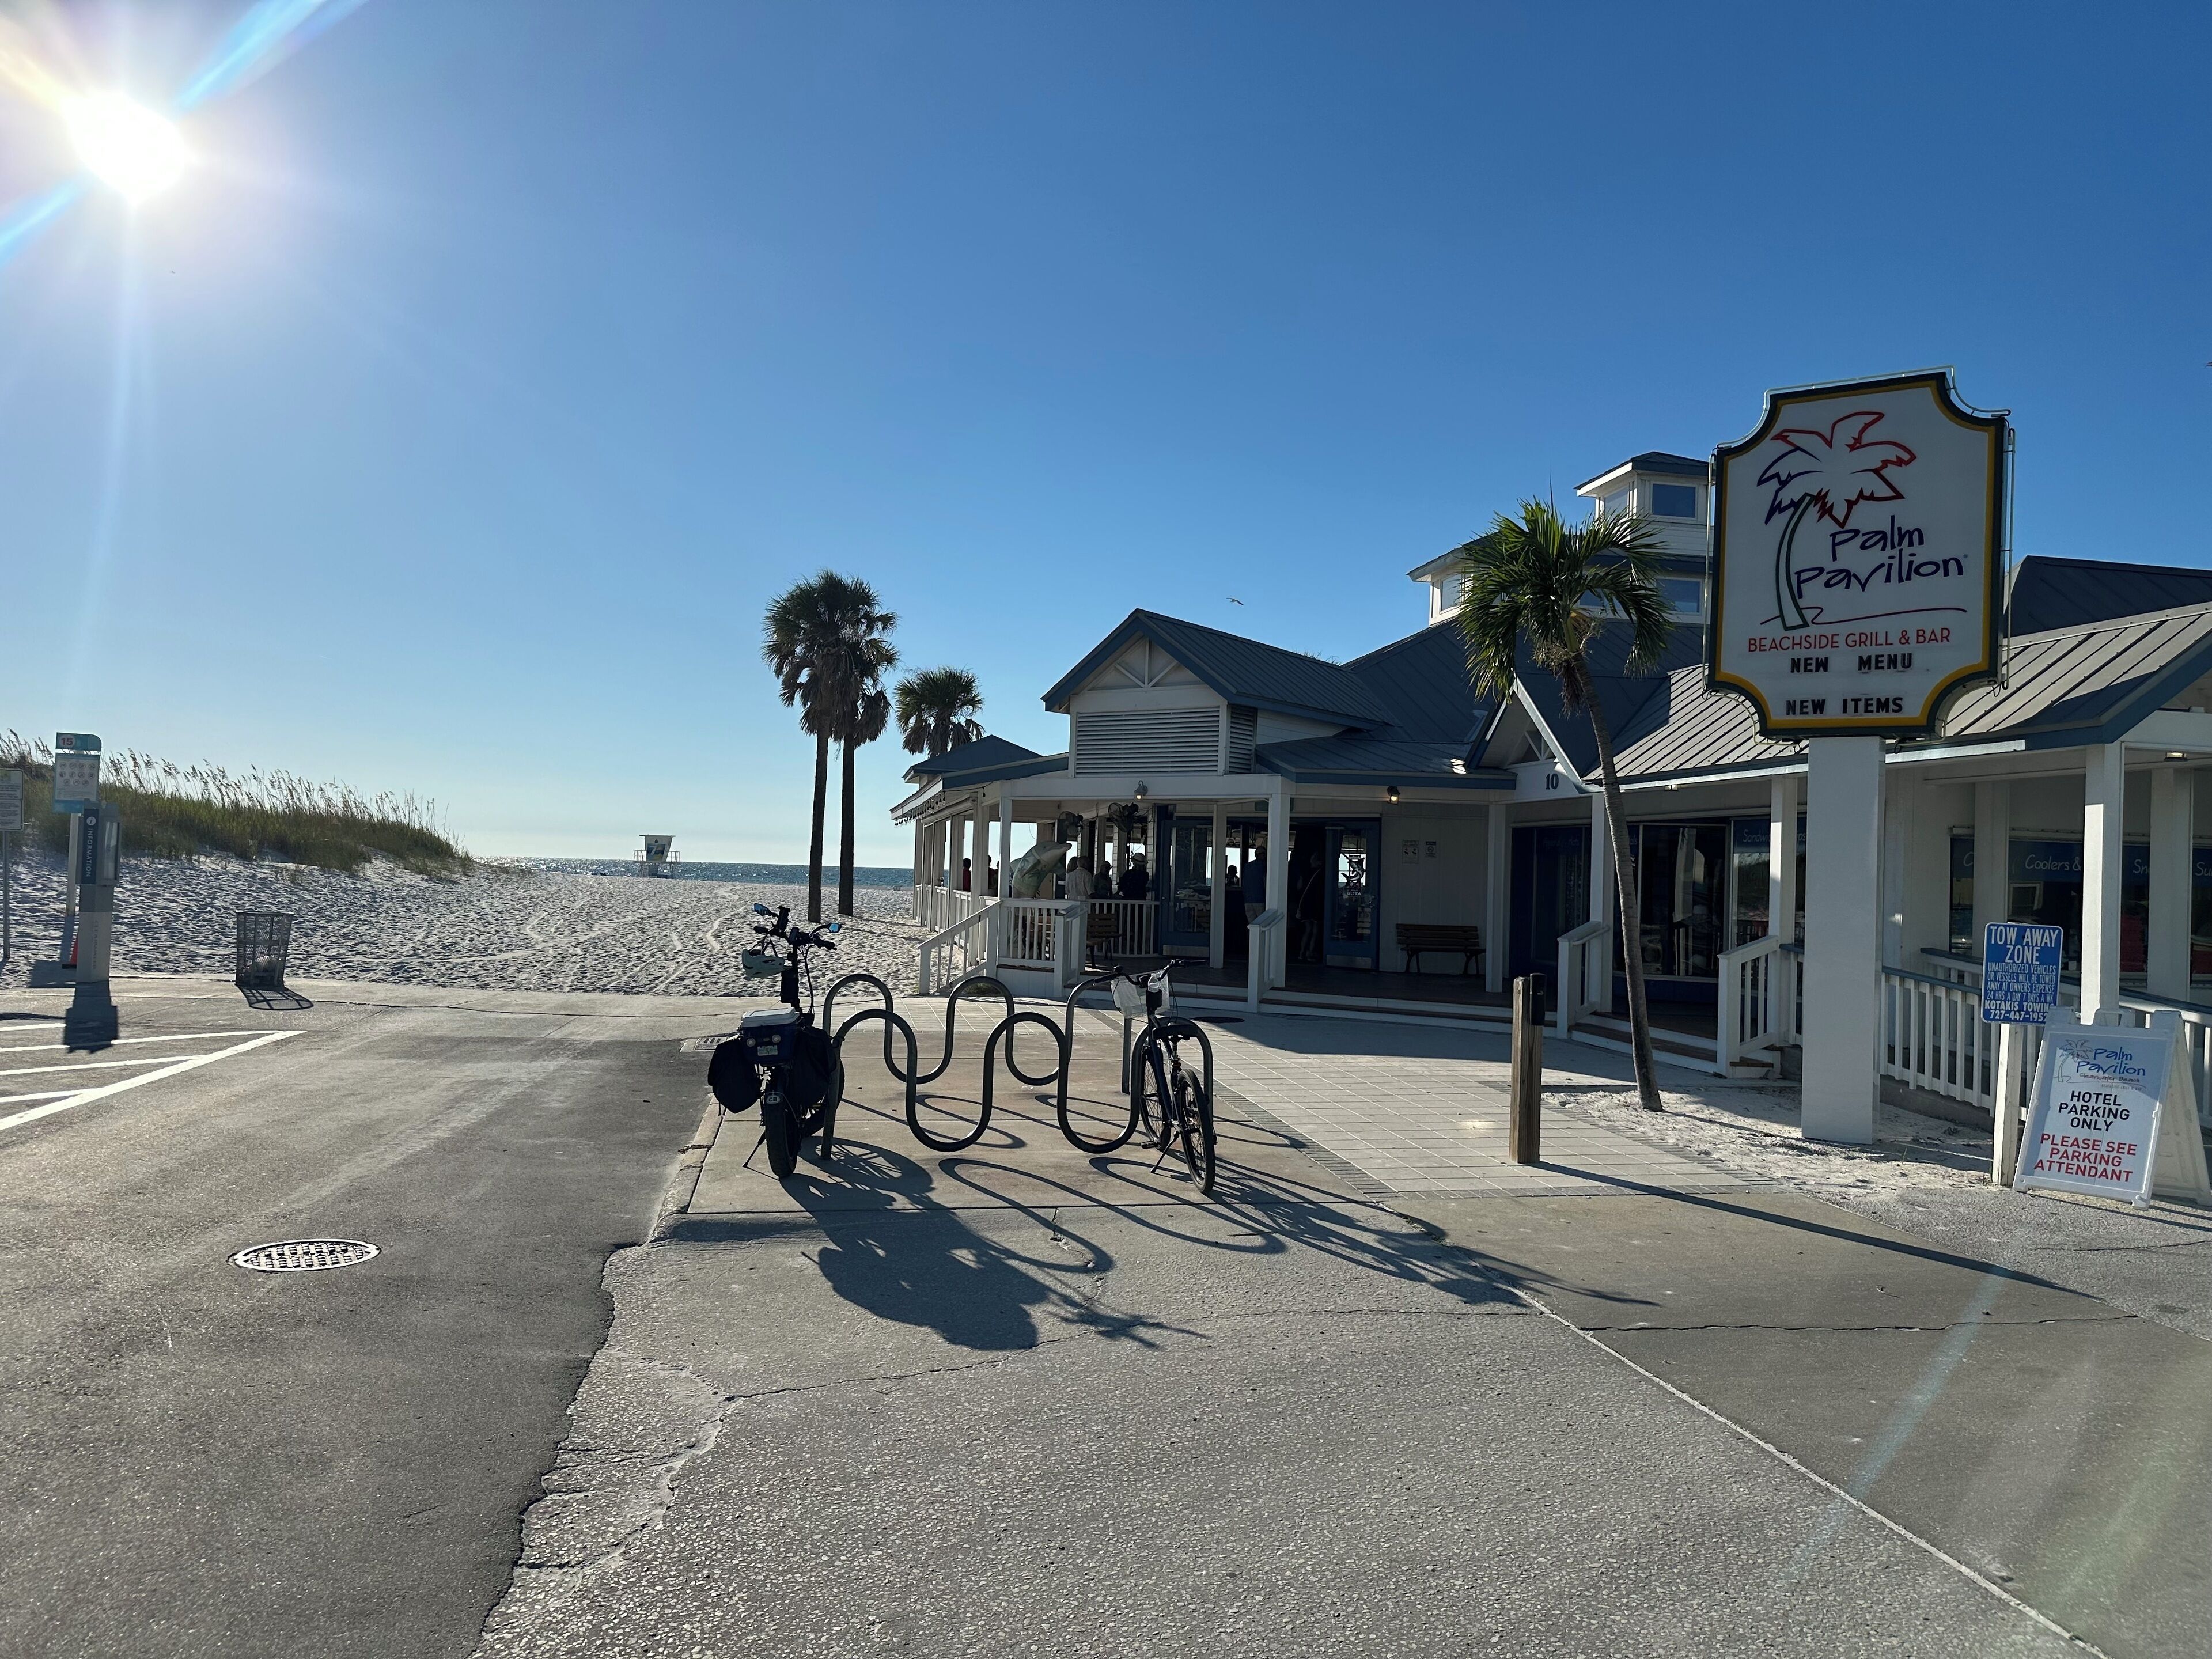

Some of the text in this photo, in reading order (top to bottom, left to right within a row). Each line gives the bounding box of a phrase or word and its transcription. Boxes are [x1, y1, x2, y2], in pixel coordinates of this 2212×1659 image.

[1748, 627, 1950, 652] BEACHSIDE GRILL & BAR
[1790, 653, 1912, 673] NEW MENU
[1786, 697, 1903, 715] NEW ITEMS
[61, 737, 74, 745] 15
[1546, 774, 1559, 790] 10
[2025, 854, 2081, 871] Coolers &
[1990, 926, 2059, 948] TOW AWAY
[2005, 945, 2040, 964] ZONE
[1988, 962, 2056, 975] UNAUTHORIZED VEHICLES
[1987, 972, 2055, 984] OR VESSELS WILL BE TOWED
[1987, 981, 2055, 994] AWAY AT OWNERS EXPENSE
[1984, 1000, 2018, 1010] KOTAKIS
[1987, 991, 2054, 1003] 24 HRS A DAY 7 DAYS A WK
[2070, 1090, 2122, 1106] HOTEL
[2058, 1102, 2130, 1120] PARKING
[2070, 1117, 2114, 1132] ONLY
[2040, 1133, 2138, 1156] PLEASE SEE
[2049, 1147, 2122, 1167] PARKING
[2033, 1159, 2133, 1182] ATTENDANT
